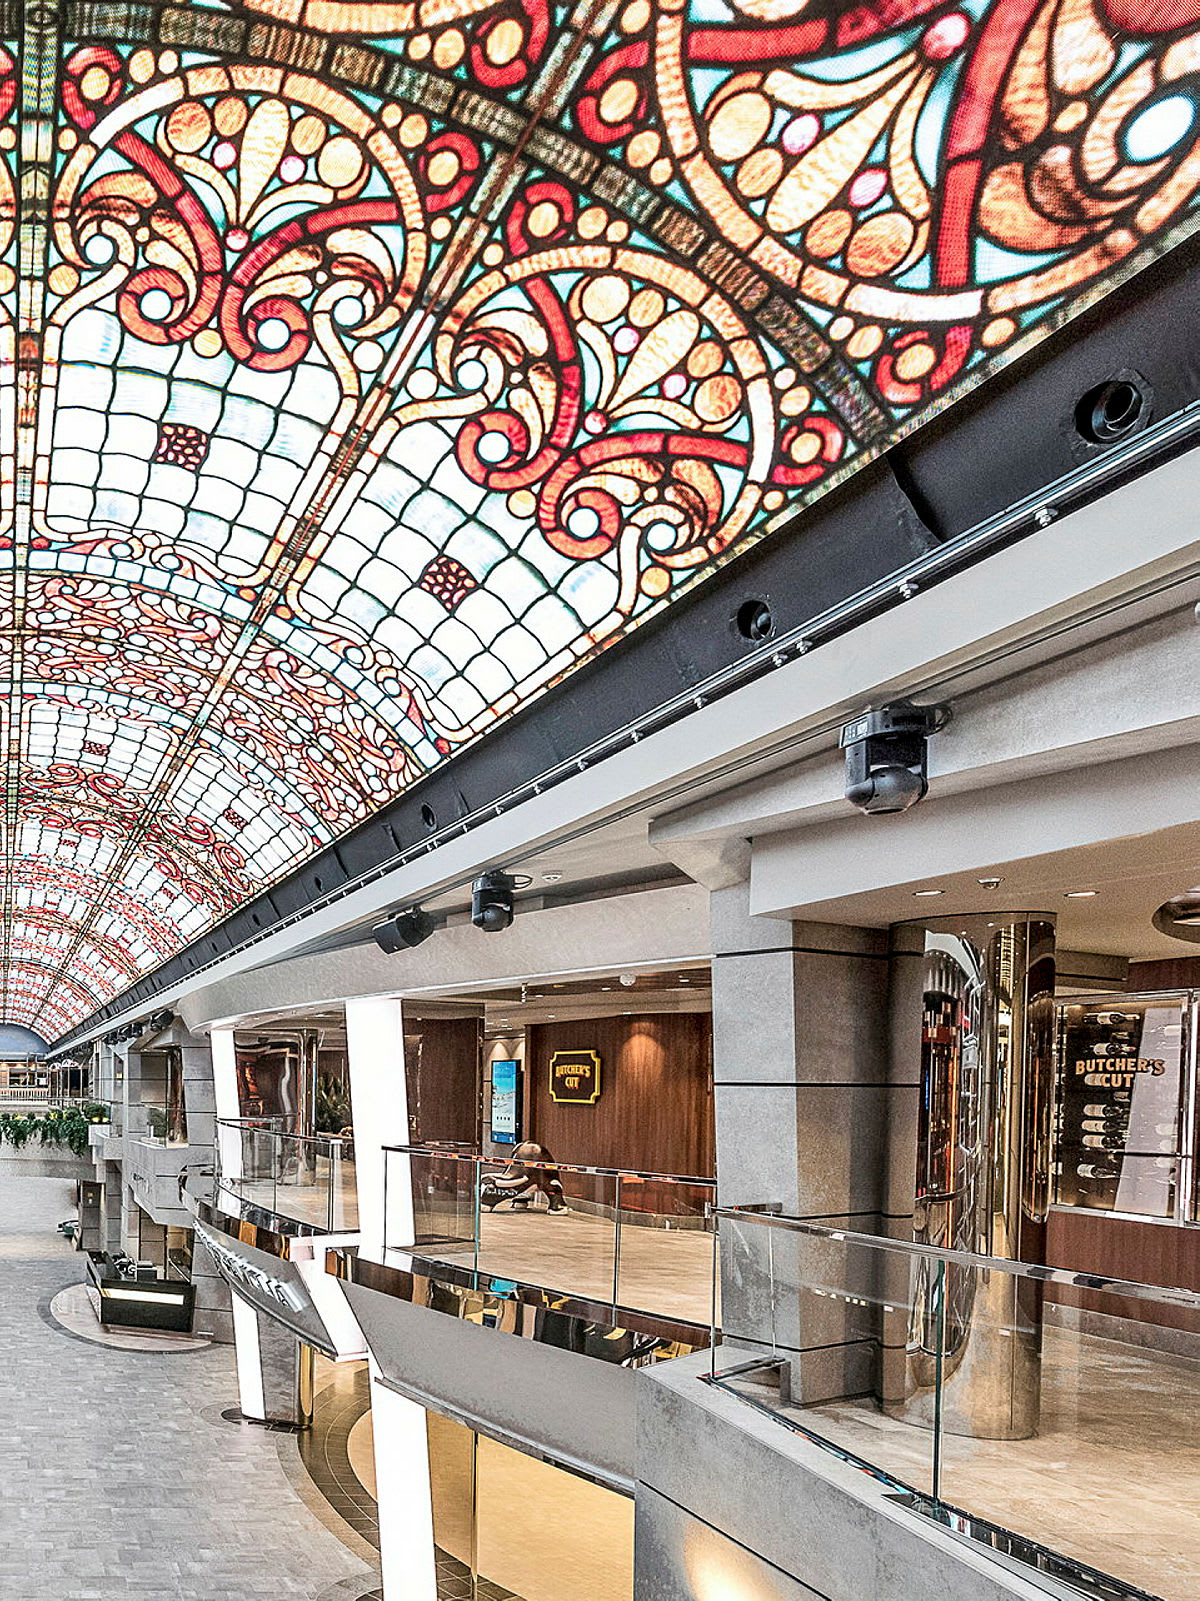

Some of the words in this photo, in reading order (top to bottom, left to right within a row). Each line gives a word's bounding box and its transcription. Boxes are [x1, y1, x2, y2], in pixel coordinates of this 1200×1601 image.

[555, 1064, 591, 1078] BUTCHER'S
[1075, 1058, 1165, 1075] BUTCHER'S
[565, 1077, 579, 1090] CUT
[1101, 1073, 1134, 1088] CUT
